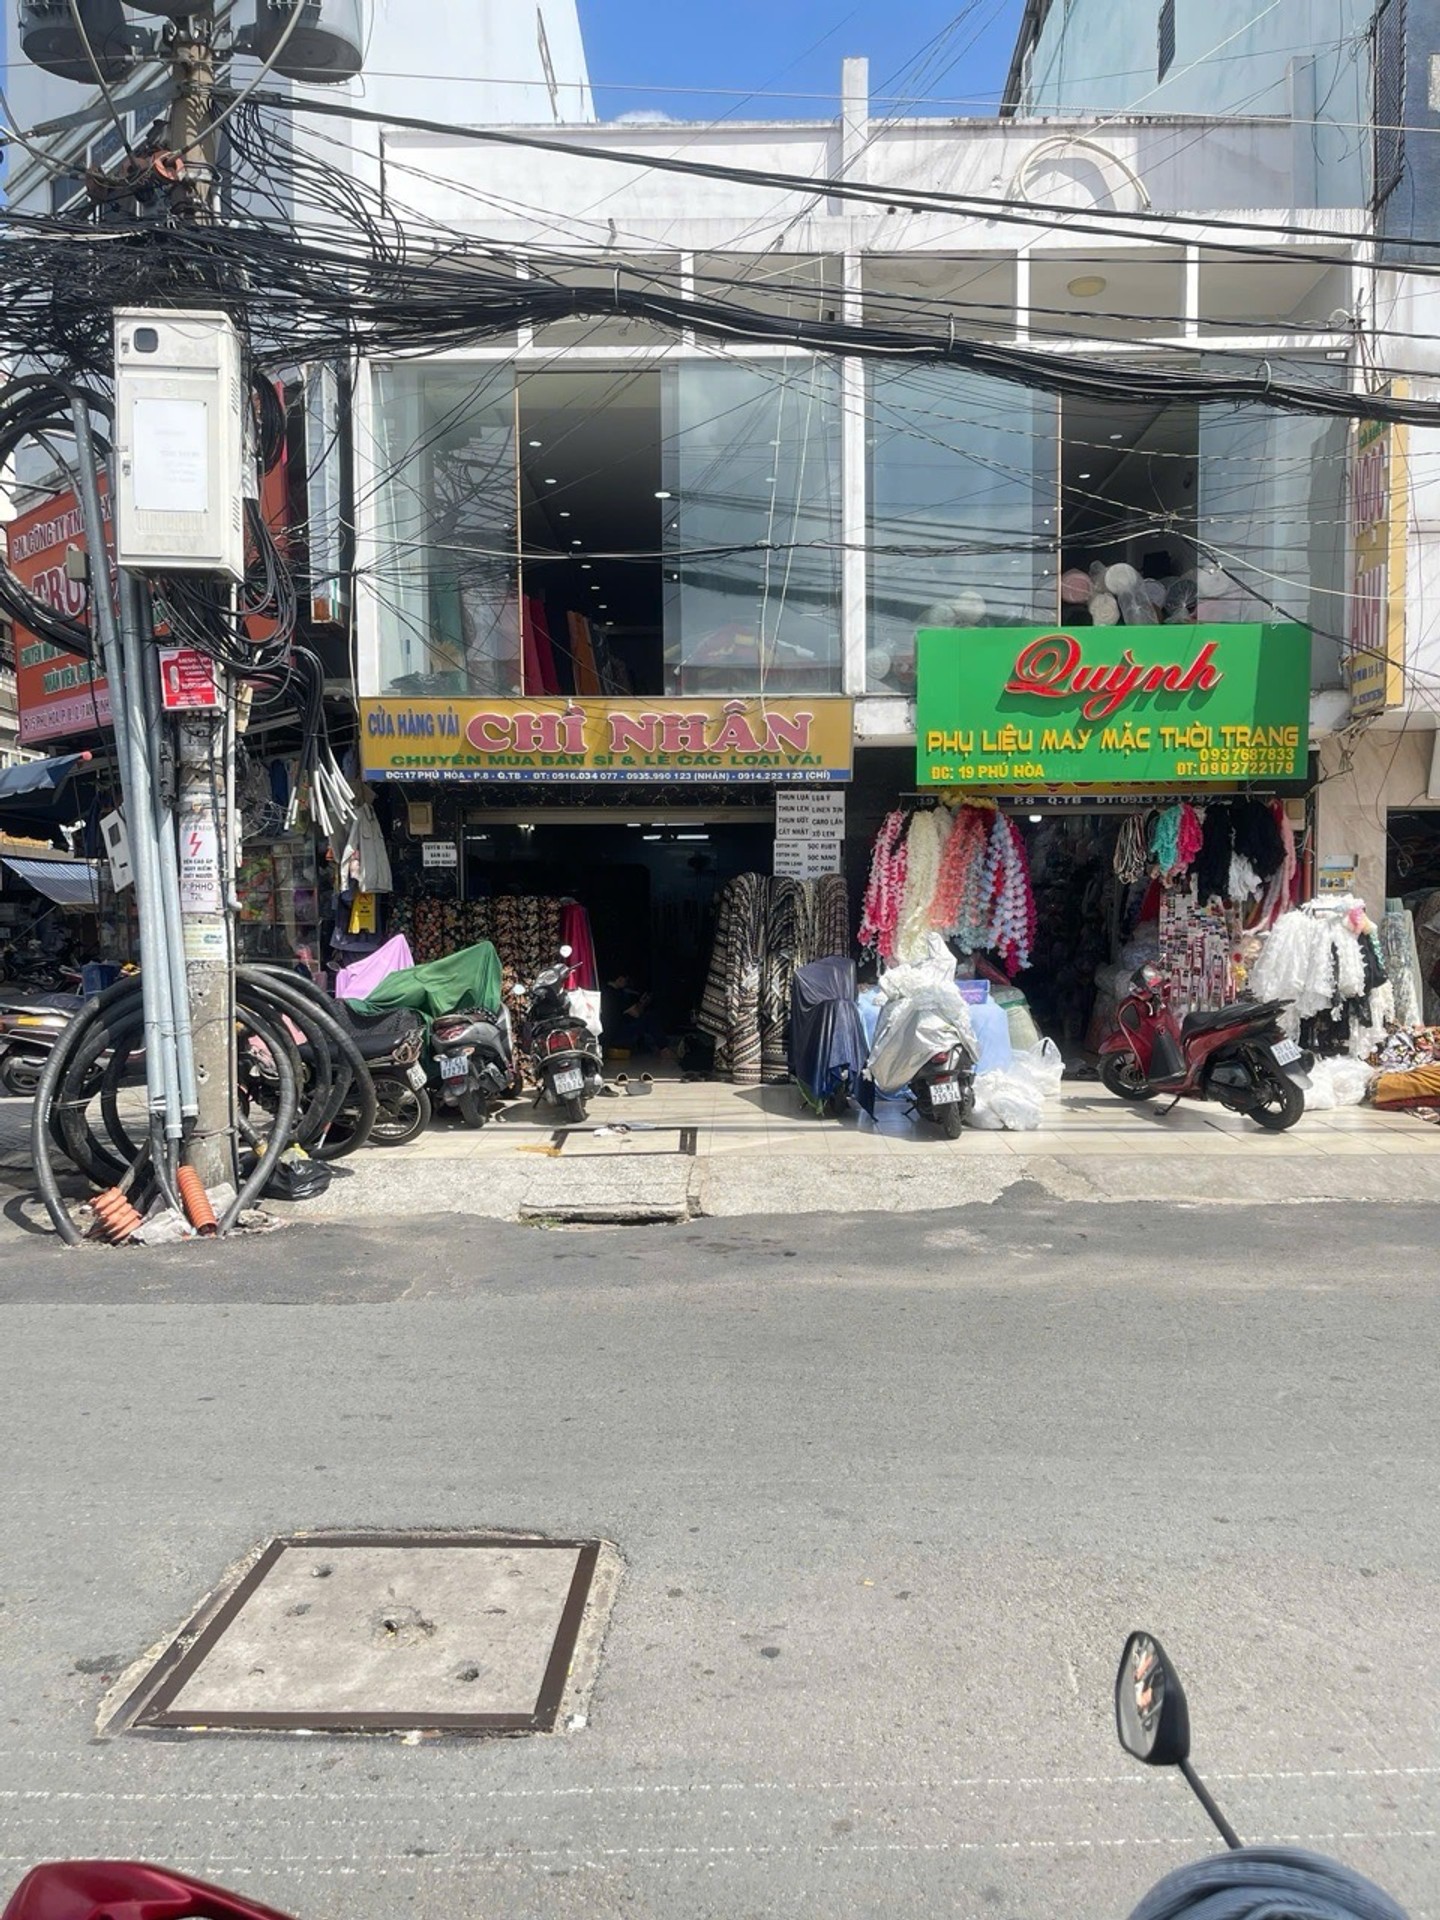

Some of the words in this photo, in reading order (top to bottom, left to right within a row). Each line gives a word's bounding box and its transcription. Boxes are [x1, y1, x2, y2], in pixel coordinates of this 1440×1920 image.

[1004, 634, 1224, 721] Quỳnh
[368, 705, 395, 737] CỬA
[399, 708, 435, 737] HÀNG
[438, 706, 461, 737] VẢI
[607, 699, 814, 753] NHÂN
[928, 731, 973, 757] PHỤ
[982, 723, 1033, 757] LIỆU
[1041, 729, 1093, 750] MAY
[1100, 721, 1151, 756] MẶC
[1159, 721, 1213, 749] THỜI
[1221, 726, 1299, 747] TRANG
[488, 754, 535, 767] MUA
[621, 754, 637, 767] &
[677, 752, 723, 767] CÁC
[730, 754, 780, 769] LOẠI
[600, 771, 618, 781] 077
[673, 771, 691, 781] 123
[786, 770, 803, 780] 123
[958, 766, 975, 779] 19
[977, 762, 1009, 779] PHÚ
[1013, 761, 1045, 778] HÒA
